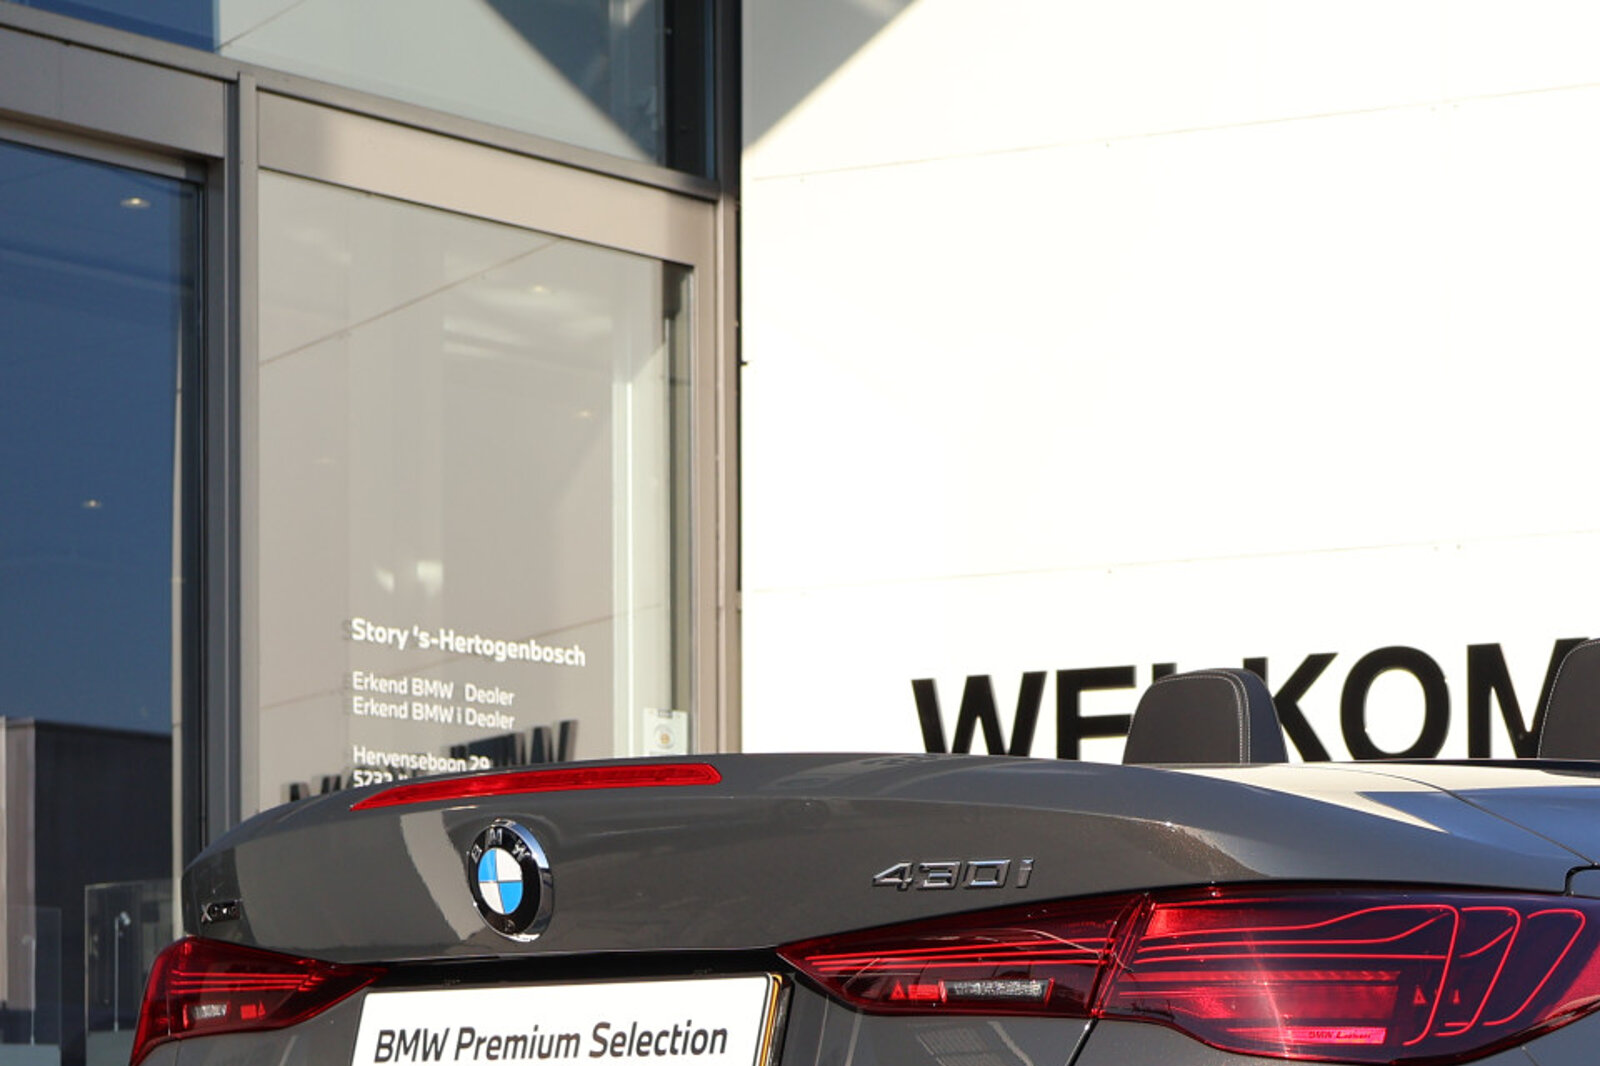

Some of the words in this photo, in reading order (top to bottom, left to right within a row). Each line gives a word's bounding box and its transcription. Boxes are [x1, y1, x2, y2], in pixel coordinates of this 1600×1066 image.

[351, 618, 409, 650] Story
[413, 625, 587, 667] 's-Hertogenbosch
[352, 671, 408, 695] Erkend
[411, 677, 455, 699] BMW
[464, 683, 516, 706] Dealer
[911, 637, 1591, 763] WEKOM
[352, 696, 408, 719] Erkend
[411, 702, 454, 723] BMW
[465, 708, 516, 730] Dealer
[352, 746, 467, 772] Hervensebaan
[872, 858, 1035, 892] 430i
[374, 1027, 450, 1064] BMW
[453, 1024, 581, 1061] Premium
[589, 1019, 728, 1058] Selection
